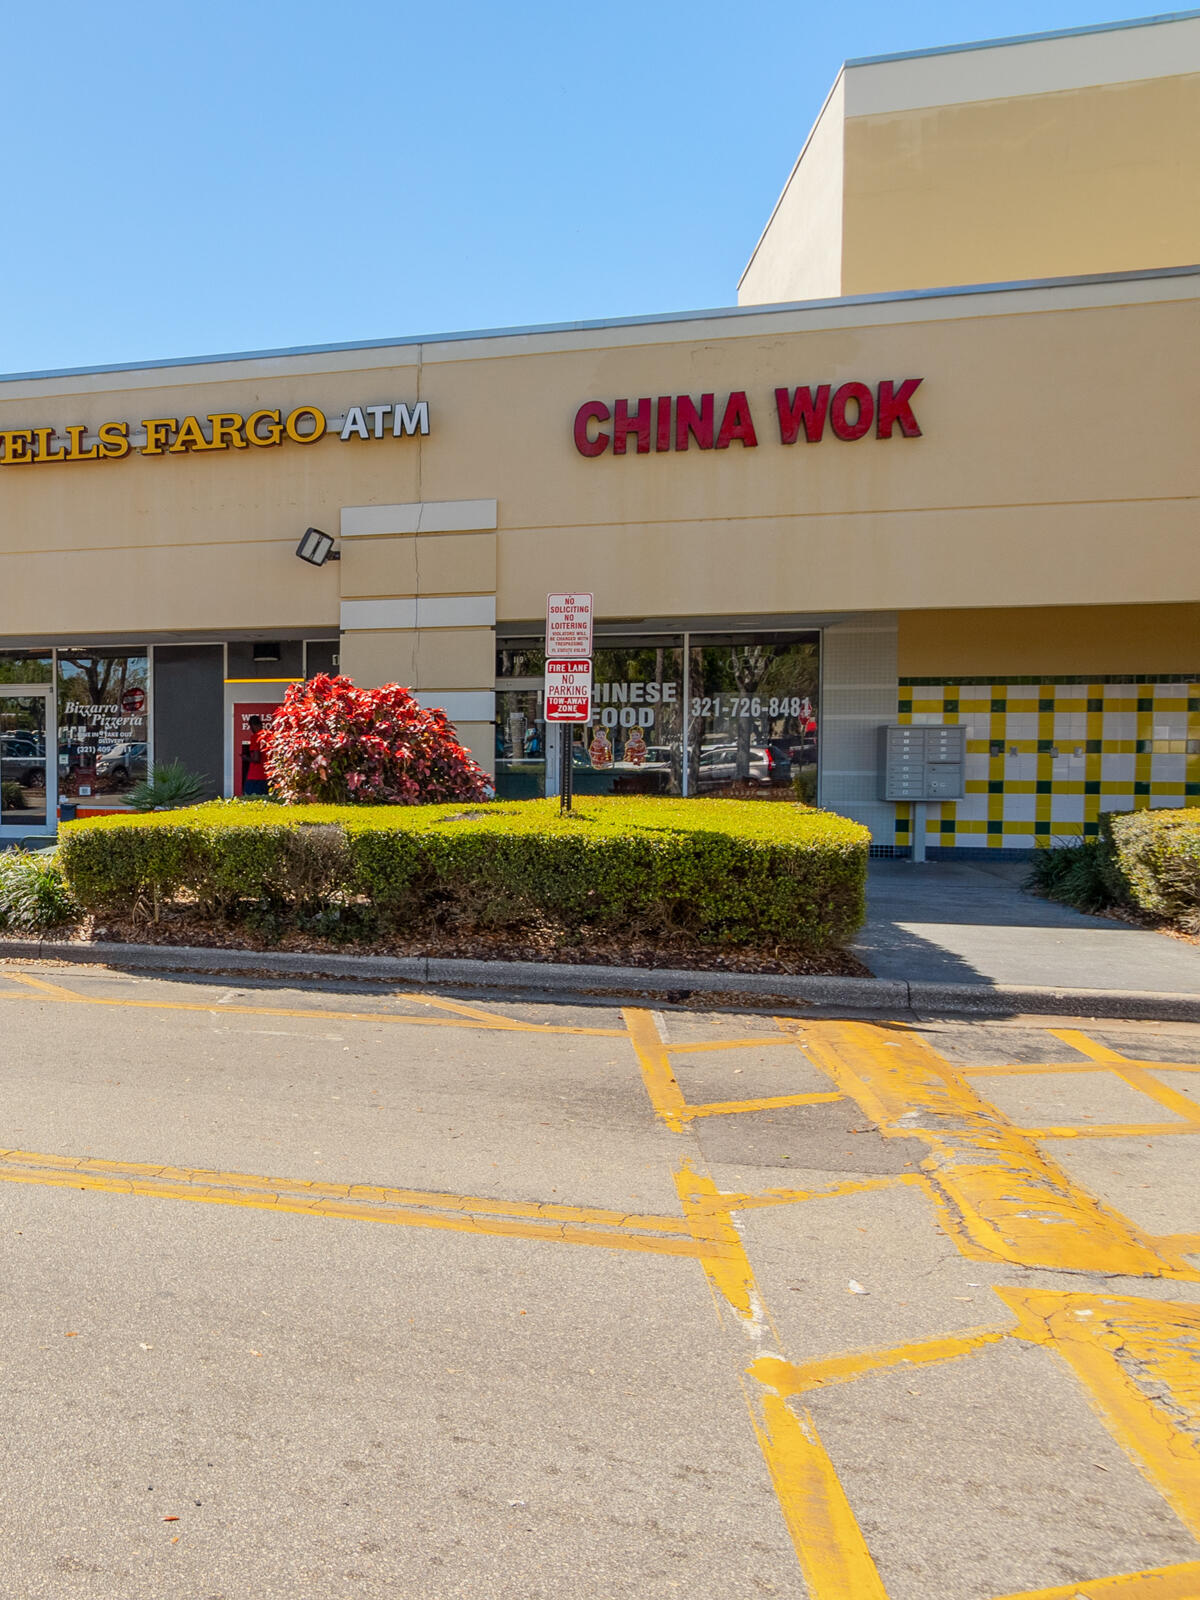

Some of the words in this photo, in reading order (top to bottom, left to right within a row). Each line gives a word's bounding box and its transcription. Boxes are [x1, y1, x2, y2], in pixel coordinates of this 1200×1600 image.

[573, 391, 758, 458] CHINA
[775, 378, 925, 445] WOK
[141, 404, 326, 456] FARGO
[340, 401, 430, 441] ATM
[551, 622, 587, 630] LOITERING
[549, 664, 566, 672] FIRE
[568, 664, 588, 672] LANE
[562, 674, 574, 684] NO
[548, 685, 587, 695] PARKING
[590, 682, 677, 702] HINESE
[64, 701, 118, 717] Bizzarro
[691, 697, 810, 717] 321-726-8481
[91, 713, 143, 729] Pizzeria
[586, 707, 655, 728] FOOD
[76, 746, 96, 754] (321)
